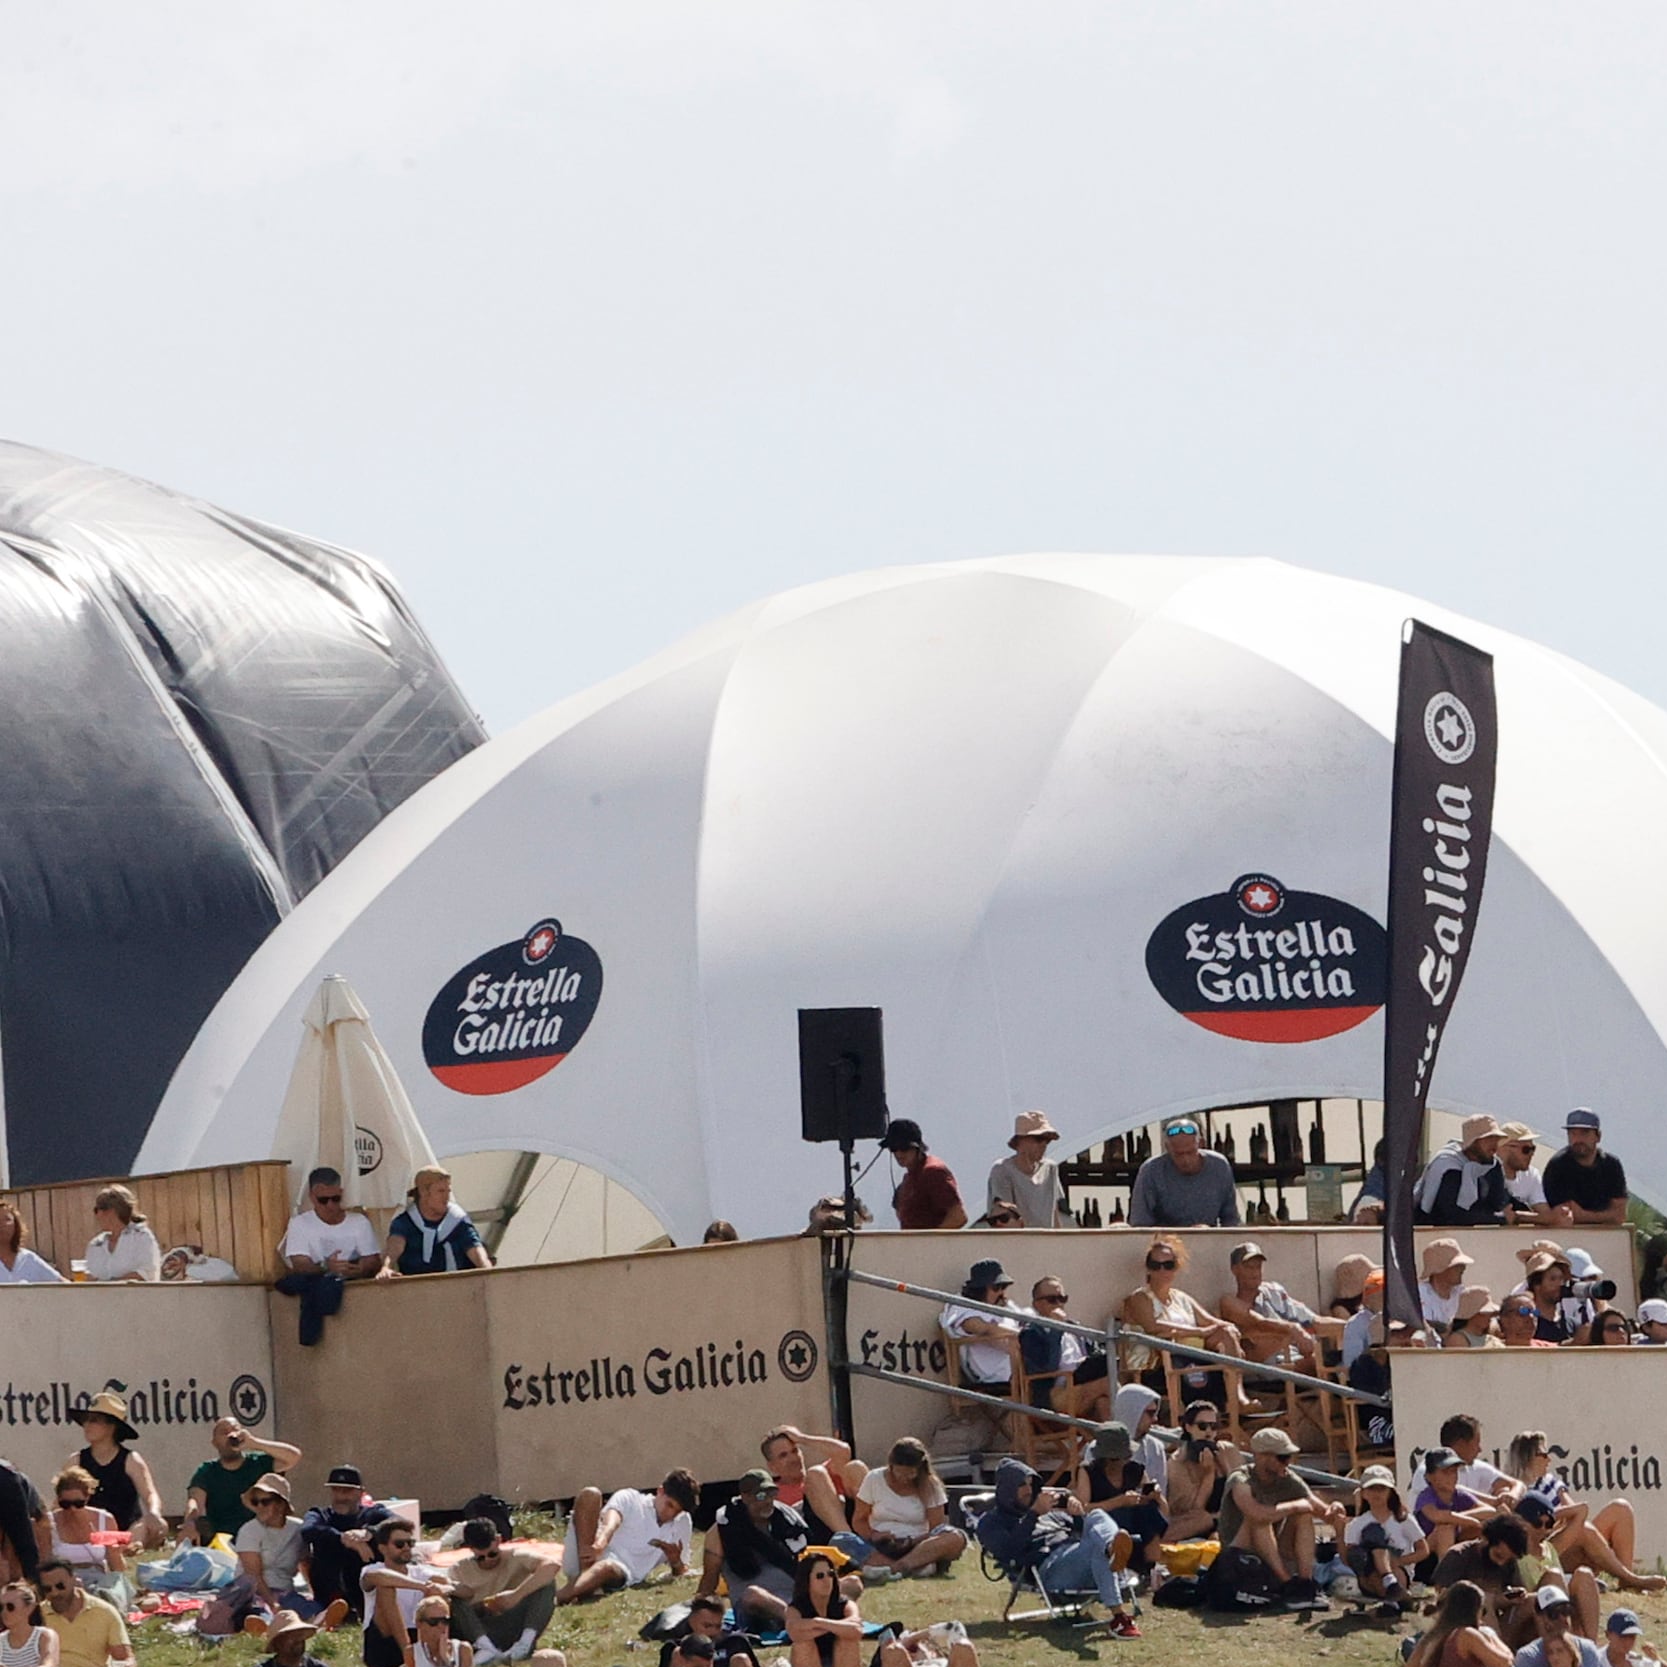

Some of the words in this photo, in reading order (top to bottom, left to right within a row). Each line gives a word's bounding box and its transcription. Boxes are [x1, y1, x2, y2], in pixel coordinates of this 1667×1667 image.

[1418, 783, 1473, 1007] Galicia
[1185, 919, 1357, 961] Estrella
[457, 966, 581, 1012] Estrella
[1196, 959, 1357, 1003] Galicia
[453, 1006, 563, 1055] Galicia
[505, 1353, 637, 1410] Estrella
[644, 1340, 767, 1395] Galicia
[860, 1329, 946, 1375] Estre
